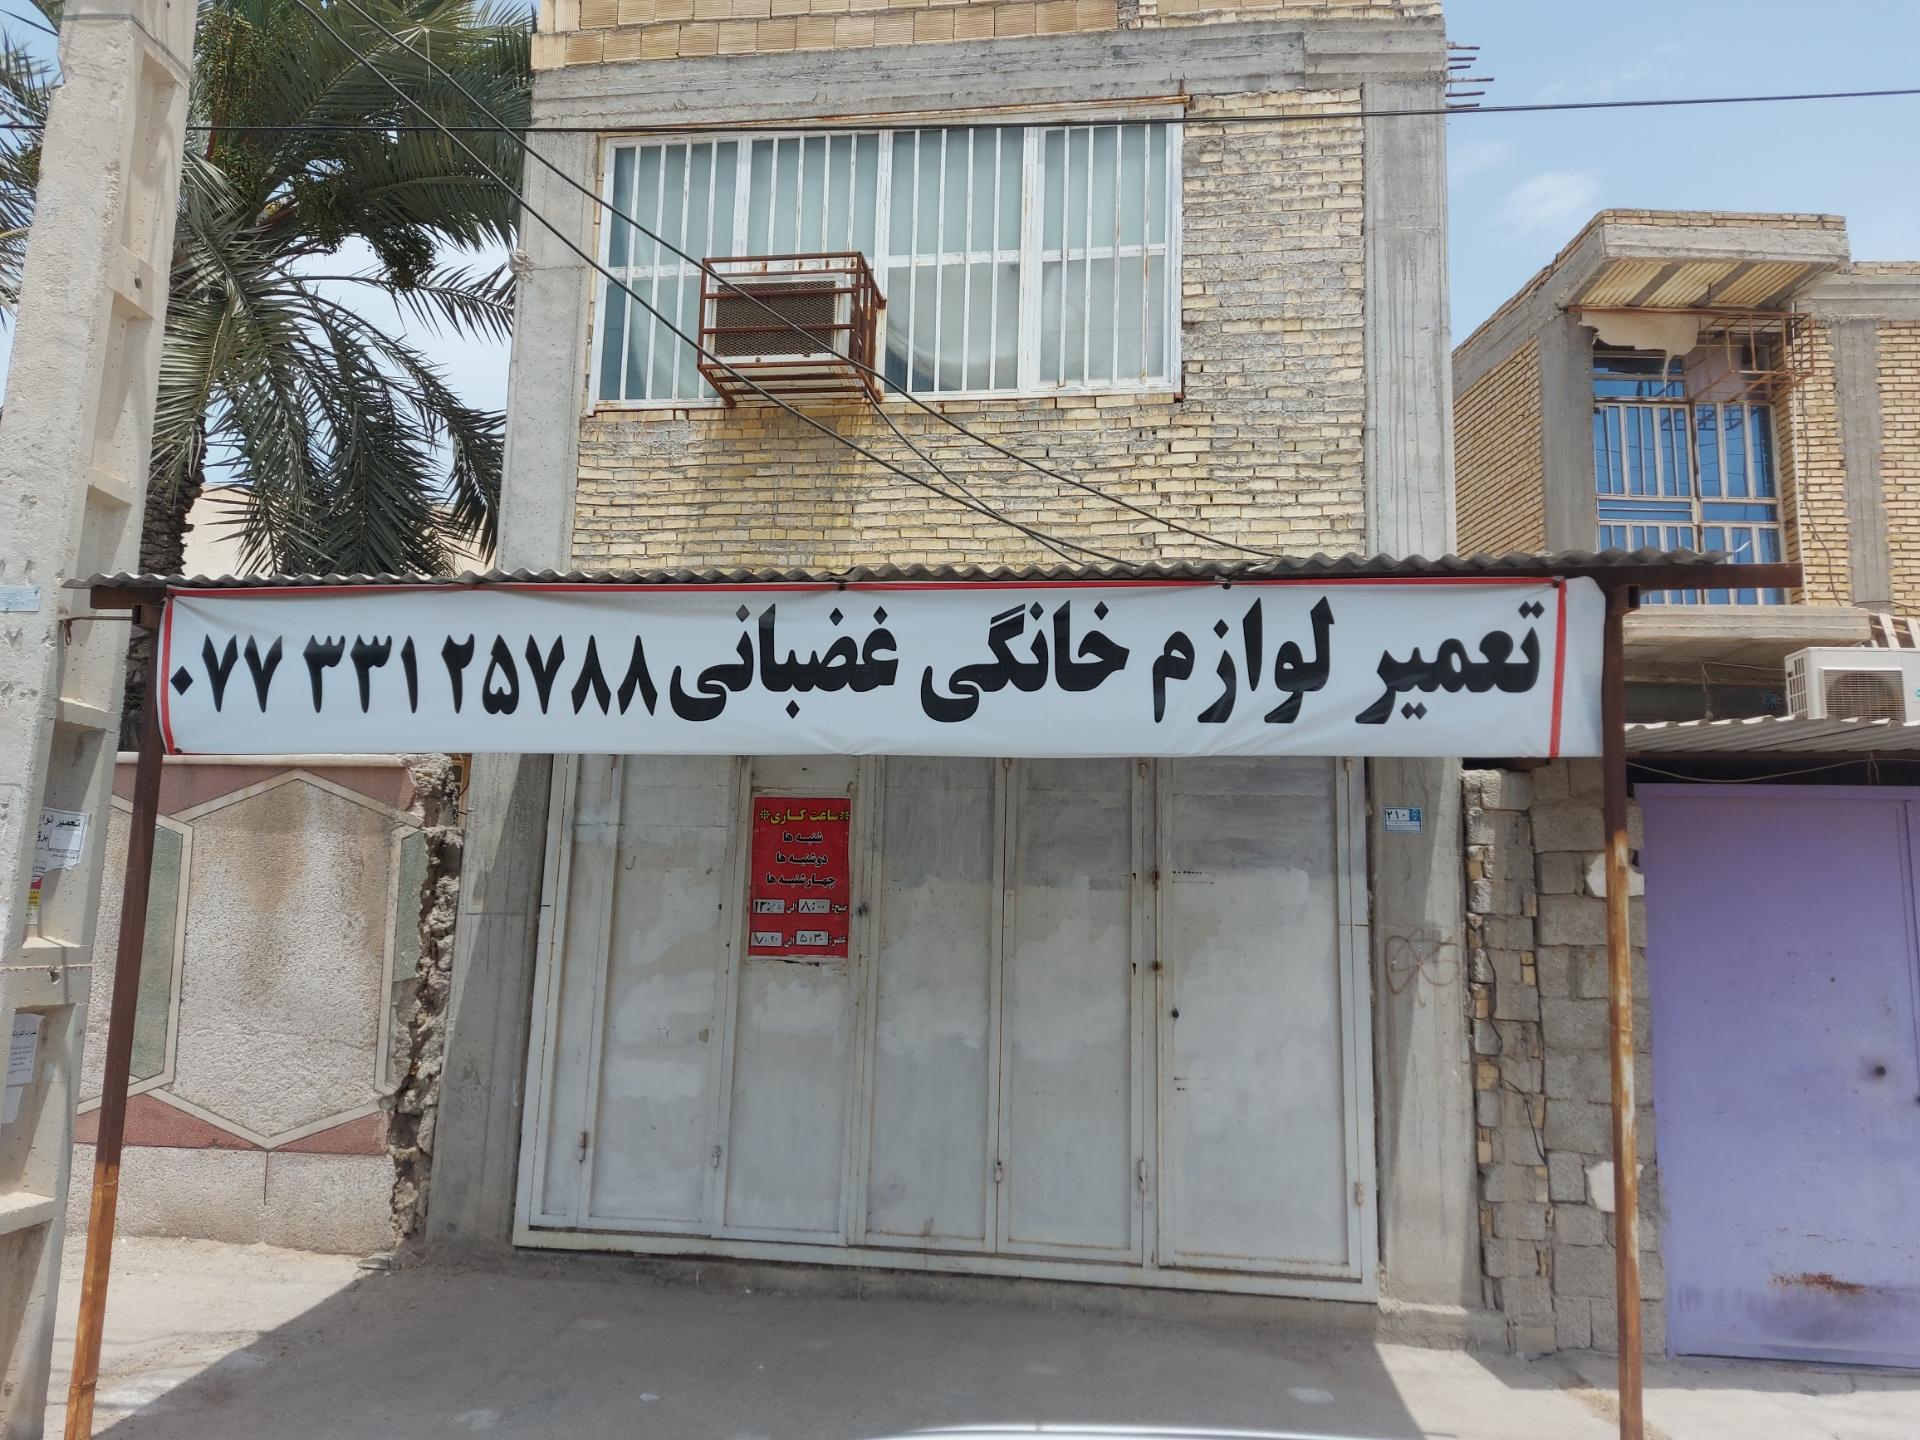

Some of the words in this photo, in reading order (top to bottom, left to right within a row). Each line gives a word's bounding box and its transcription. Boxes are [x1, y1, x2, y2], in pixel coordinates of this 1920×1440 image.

[670, 603, 899, 721] غضبانی
[920, 600, 1130, 722] خانگی
[1152, 596, 1335, 723] لوازم
[1355, 600, 1545, 724] تعمیر
[770, 808, 807, 825] کاری
[809, 808, 839, 821] ساعت
[782, 830, 793, 843] ها
[795, 831, 824, 846] شنبه
[776, 851, 787, 864] ها
[788, 852, 829, 868] دوشنبه
[766, 872, 776, 885] ها
[778, 873, 836, 889] چهارشنبه
